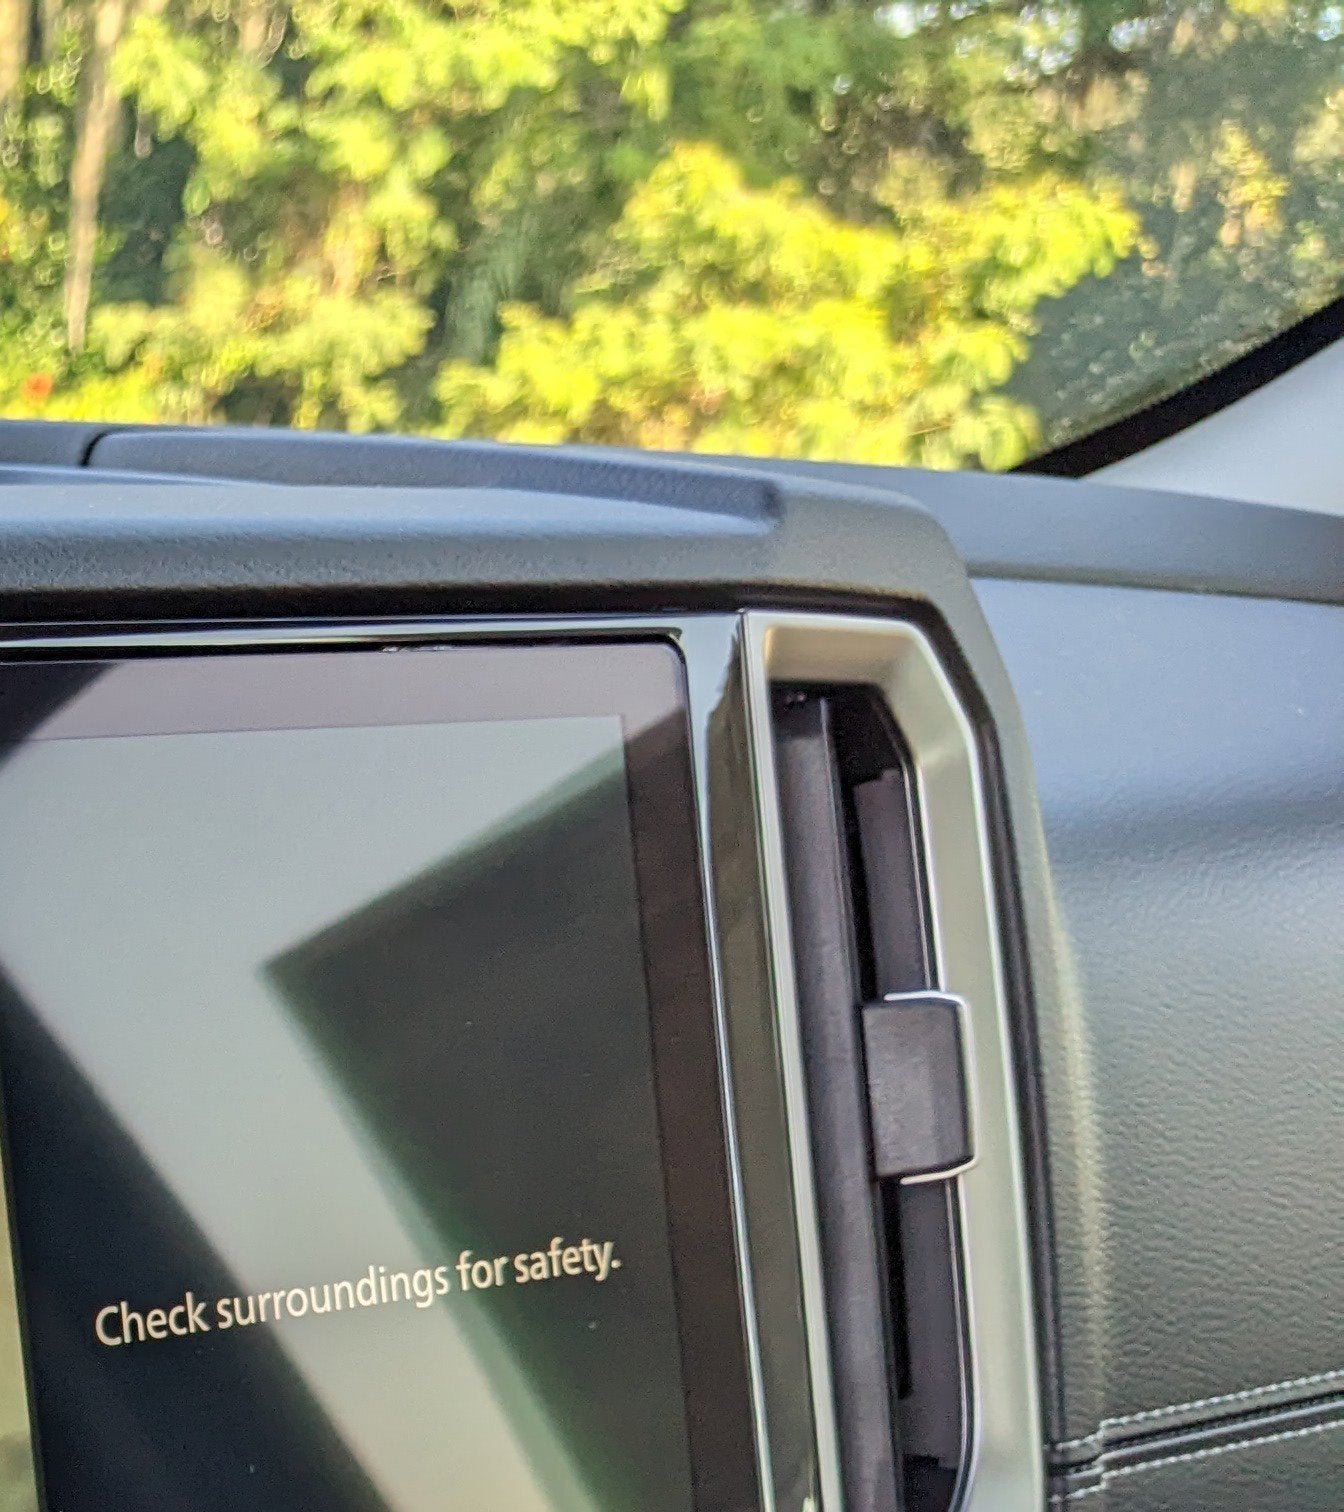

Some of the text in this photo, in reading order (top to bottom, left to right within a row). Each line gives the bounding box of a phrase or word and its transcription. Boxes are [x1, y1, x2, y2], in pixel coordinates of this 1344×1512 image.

[94, 1236, 621, 1346] Check surroundings for safety.
